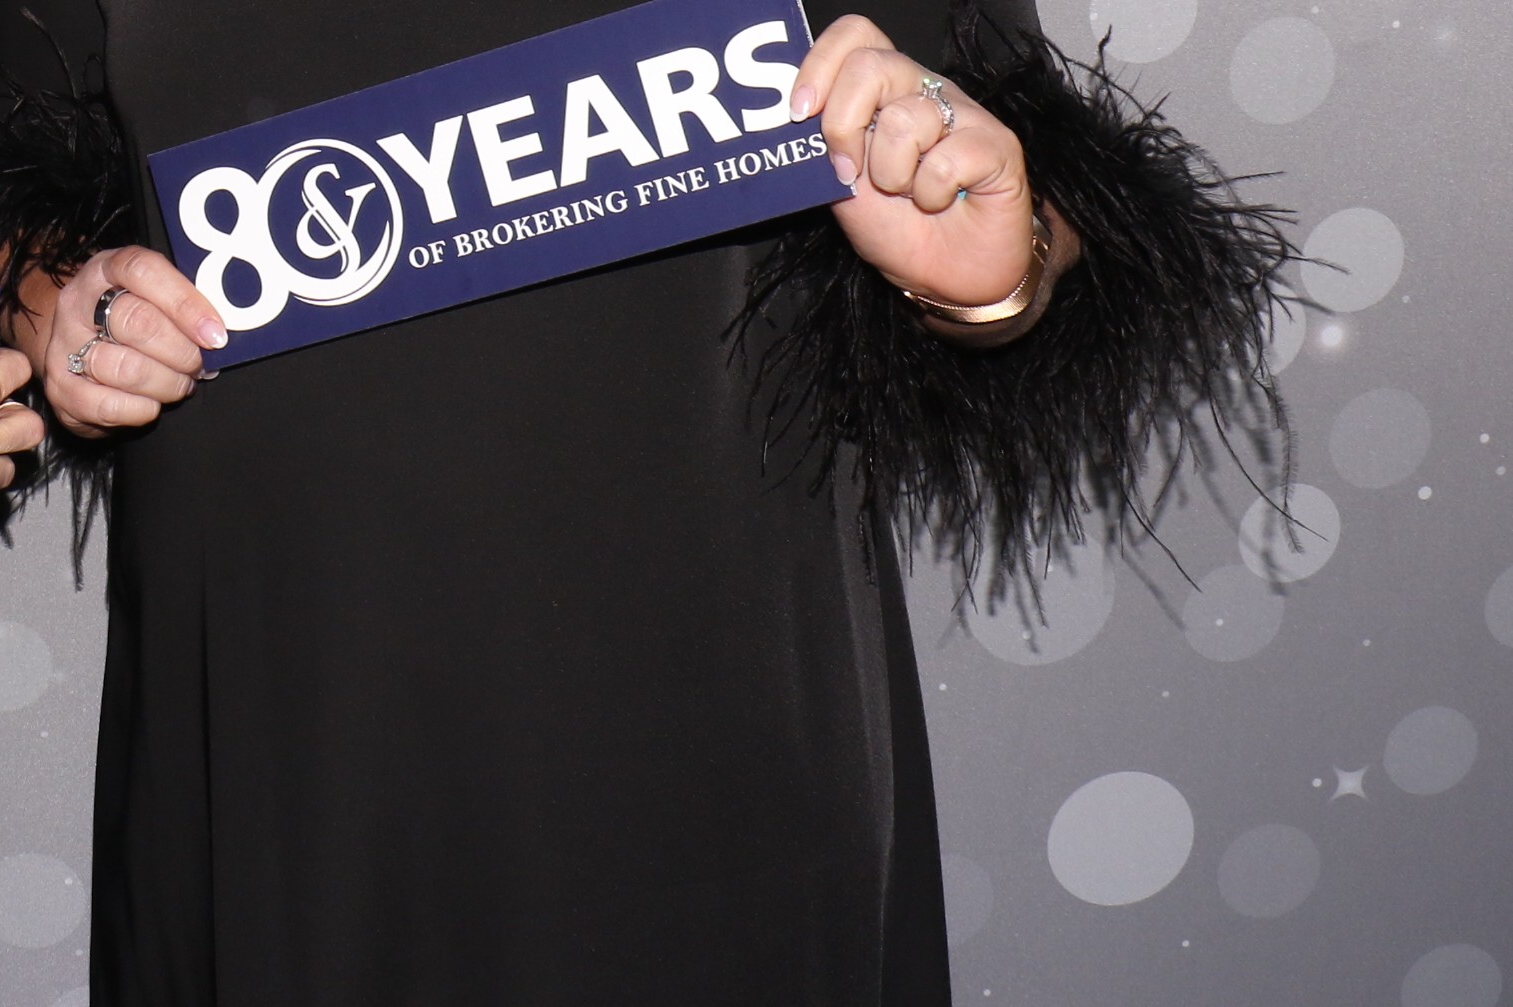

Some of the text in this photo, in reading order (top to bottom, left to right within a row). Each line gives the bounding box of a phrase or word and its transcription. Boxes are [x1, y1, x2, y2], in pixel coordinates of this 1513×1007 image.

[376, 20, 804, 224] YEARS
[408, 132, 829, 270] OF BROKERING FINE HOMES
